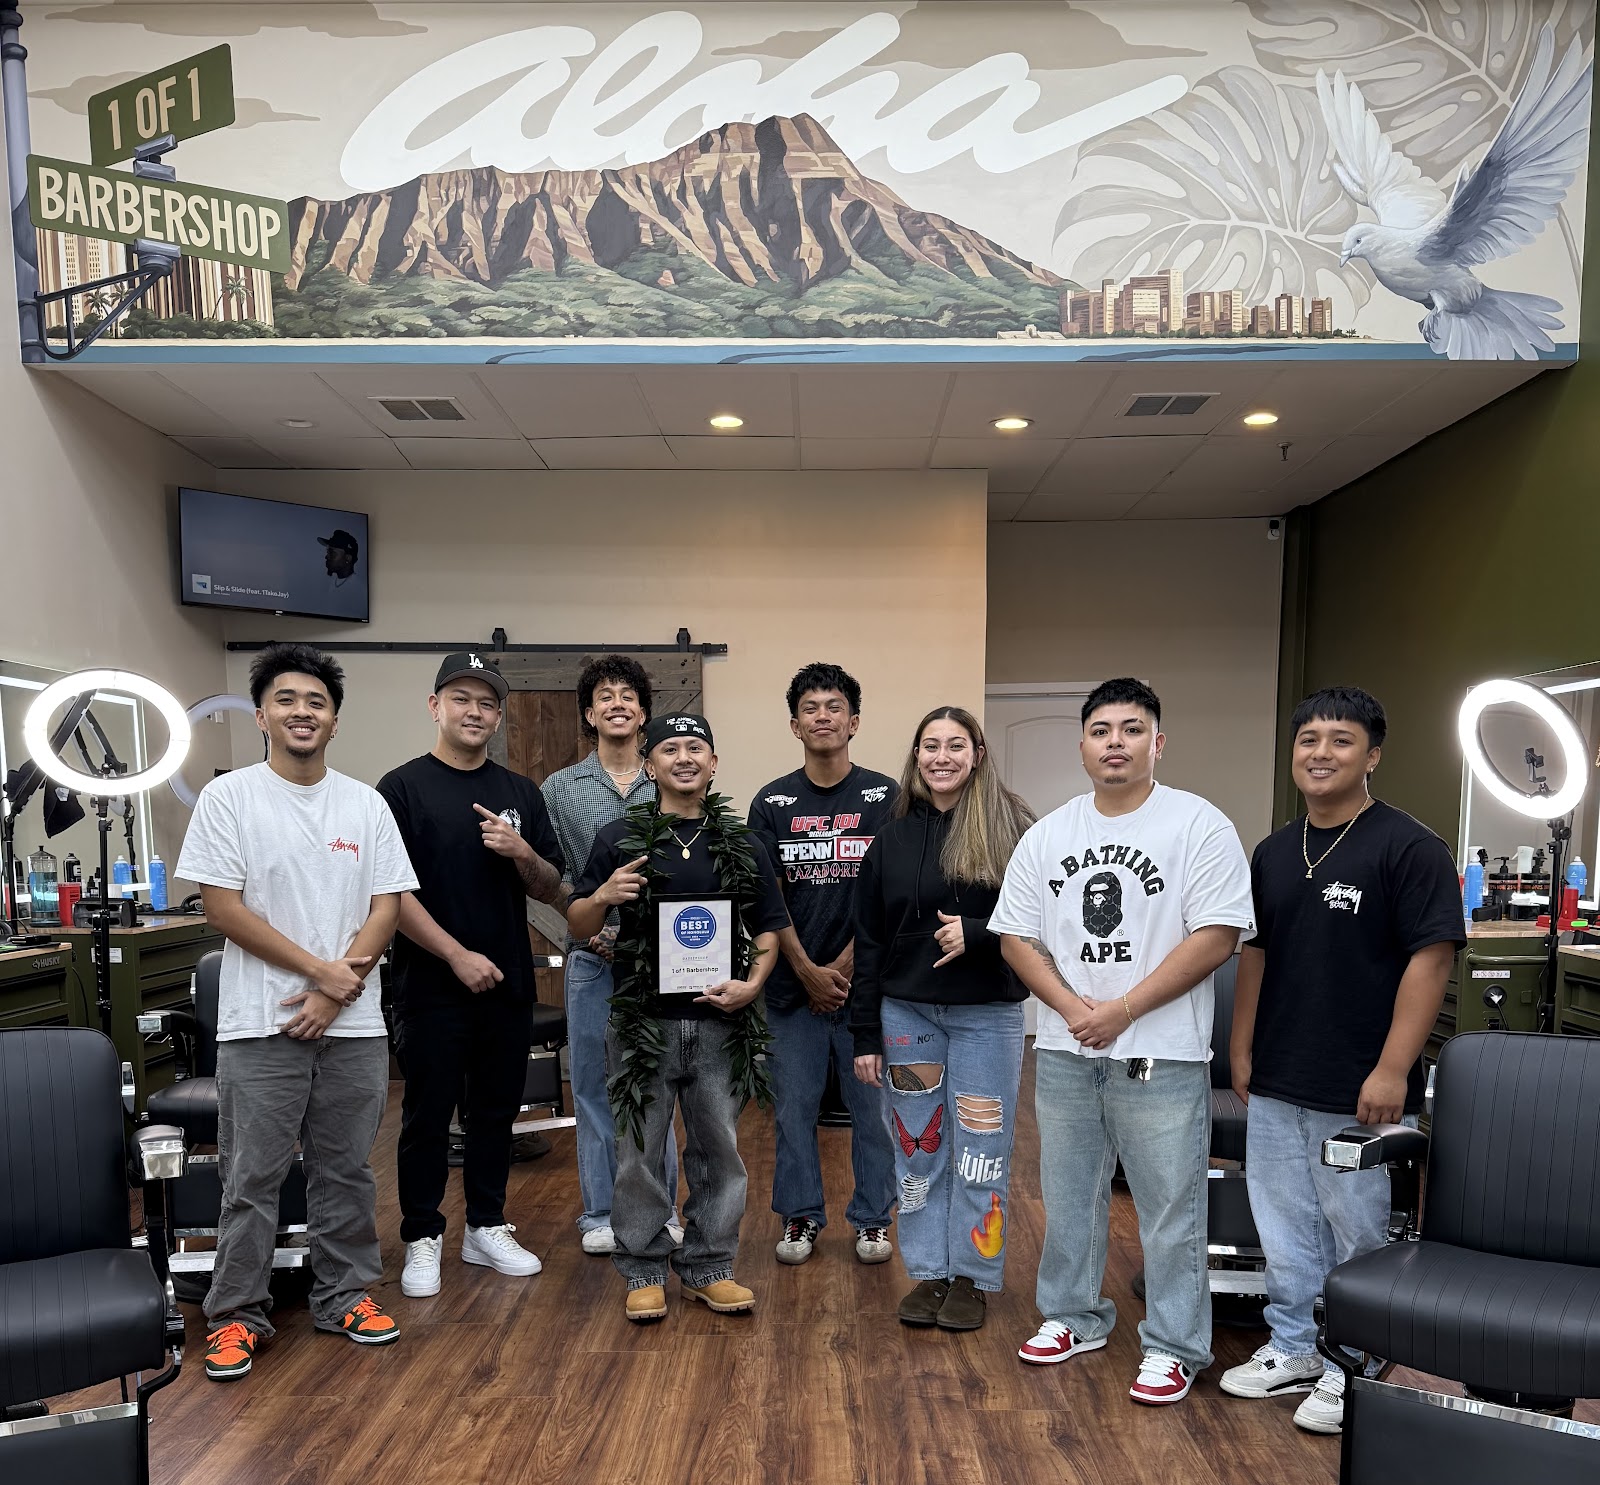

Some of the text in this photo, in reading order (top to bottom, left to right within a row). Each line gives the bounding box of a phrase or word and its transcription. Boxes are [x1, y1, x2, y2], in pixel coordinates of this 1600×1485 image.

[107, 67, 201, 150] 1 OF 1
[38, 166, 281, 260] BARBERSHOP
[213, 584, 226, 592] Slip
[468, 653, 484, 669] LA
[790, 812, 862, 833] UFC 101
[1048, 844, 1165, 898] A BATHING
[810, 877, 840, 886] TEQUILA
[680, 920, 710, 931] BEST
[1080, 940, 1132, 963] APE
[40, 956, 61, 967] HUSKY
[917, 1033, 935, 1044] NOT
